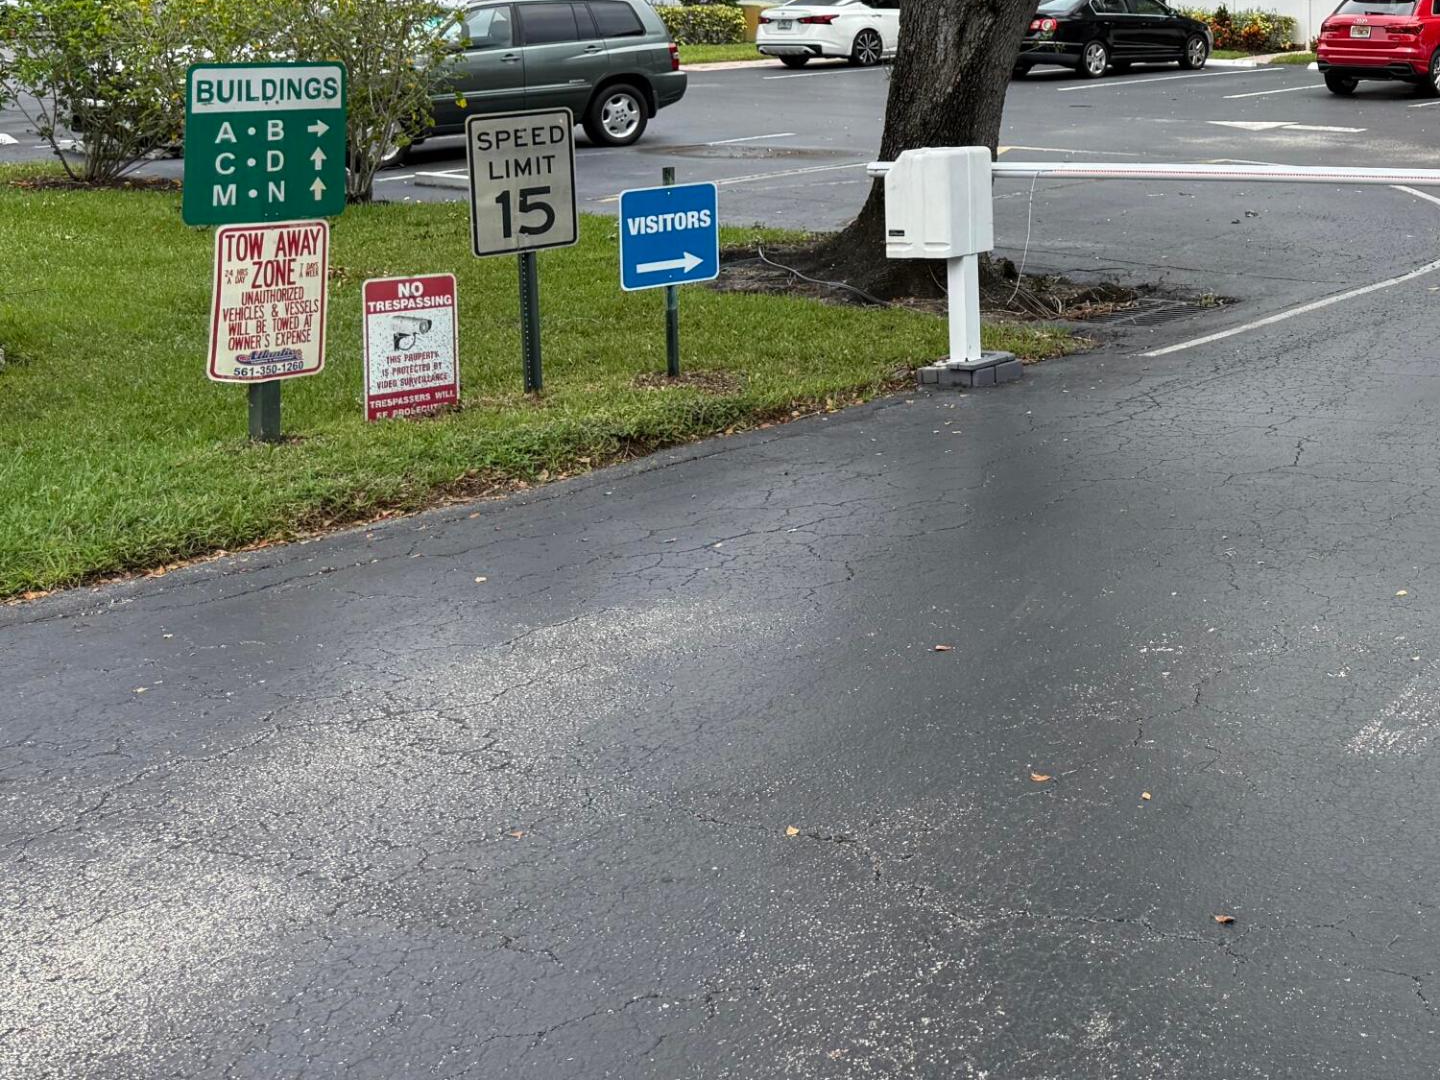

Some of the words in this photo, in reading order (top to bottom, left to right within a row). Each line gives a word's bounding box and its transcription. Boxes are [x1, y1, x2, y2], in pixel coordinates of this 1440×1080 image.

[196, 77, 338, 103] BUILDINGS
[214, 121, 237, 144] A
[267, 119, 285, 141] B
[477, 125, 565, 151] SPEED
[214, 152, 236, 175] C
[266, 150, 285, 172] D
[489, 155, 556, 180] LIMIT
[212, 183, 237, 207] M
[268, 180, 285, 203] N
[495, 185, 556, 238] 15
[627, 209, 711, 236] VISITORS
[225, 231, 265, 262] TOW
[275, 228, 321, 258] AWAY
[224, 269, 234, 278] 24
[236, 267, 248, 278] HRS
[251, 258, 297, 289] ZONE
[305, 269, 319, 278] WEEK
[306, 261, 319, 270] DAYS
[234, 276, 247, 285] DAY
[398, 281, 424, 298] NO
[241, 287, 304, 306] UNAUTHORIZED
[367, 295, 452, 312] TRESPASSING
[223, 305, 265, 323] VEHICLES
[271, 303, 279, 318] &
[284, 299, 319, 315] VESSELS
[228, 320, 251, 337] WILL
[256, 319, 267, 334] BE
[272, 316, 300, 332] TOWED
[304, 314, 313, 328] AT
[228, 333, 271, 351] OWNER'S
[275, 328, 312, 347] EXPENSE
[234, 361, 304, 376] 561-350-1260
[386, 353, 401, 364] THIS
[403, 350, 440, 362] PROPERTY
[382, 369, 390, 379] IS
[391, 363, 431, 376] PROTECTED
[433, 361, 443, 372] BY
[376, 379, 397, 391] VIDEO
[400, 373, 449, 387] SURVEILLANCE
[369, 393, 431, 409] TRESPASSERS
[435, 390, 456, 399] WILL
